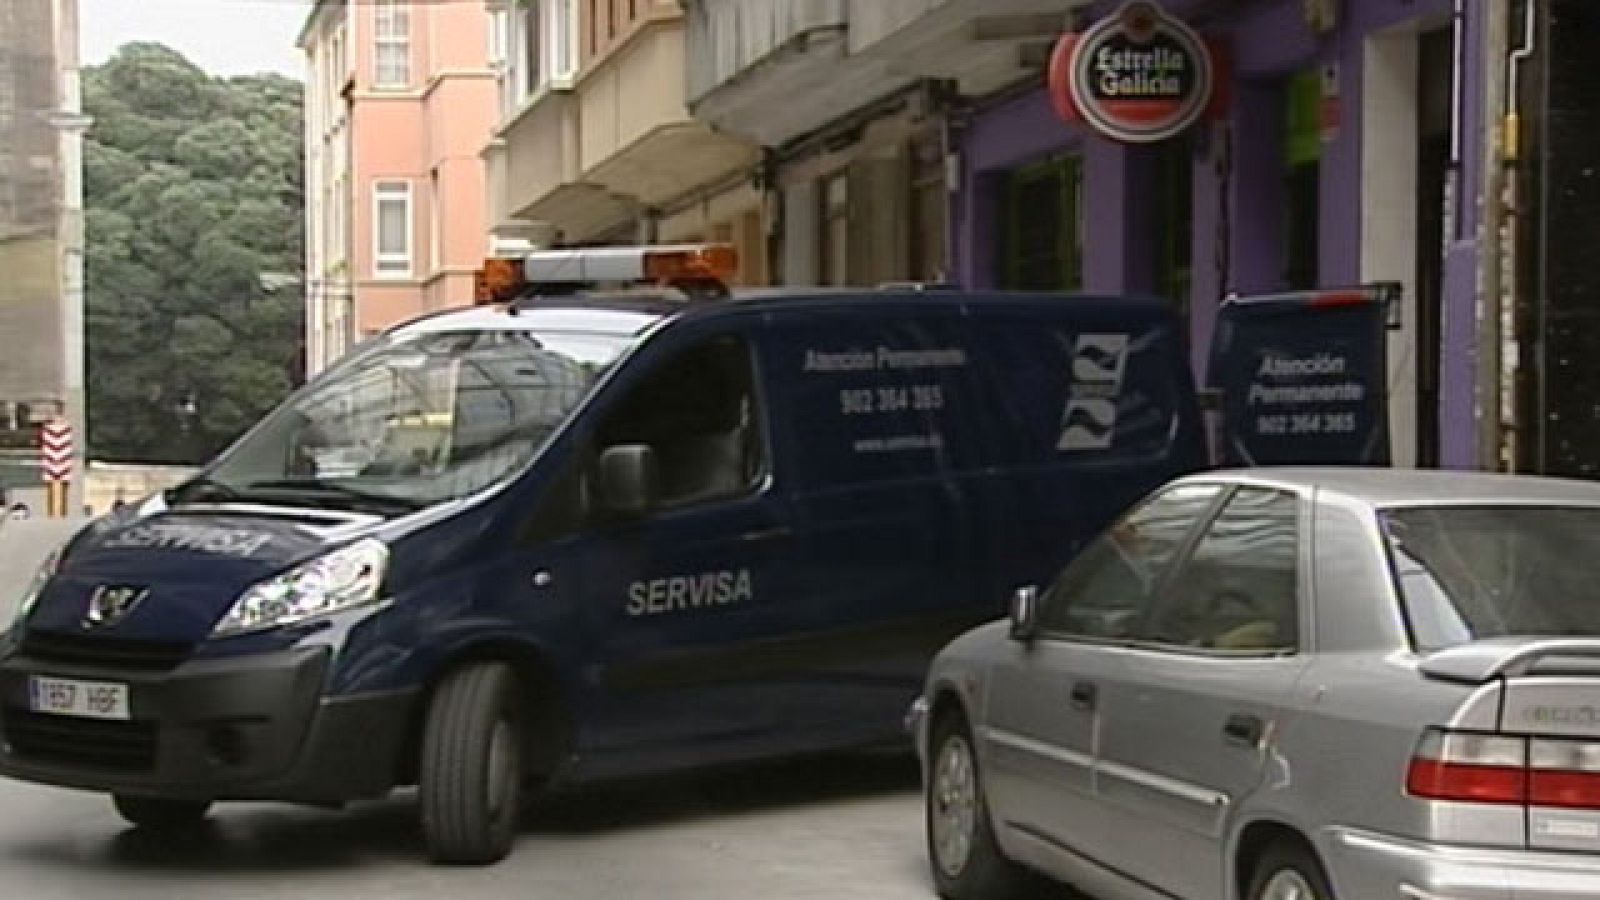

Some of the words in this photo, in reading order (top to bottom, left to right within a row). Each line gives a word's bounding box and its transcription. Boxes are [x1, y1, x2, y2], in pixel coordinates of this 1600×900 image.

[1096, 47, 1184, 71] Estrella
[1100, 71, 1180, 96] Galicia
[1248, 383, 1364, 406] Permanente
[103, 525, 273, 557] SERVISA
[626, 568, 753, 616] SERVISA
